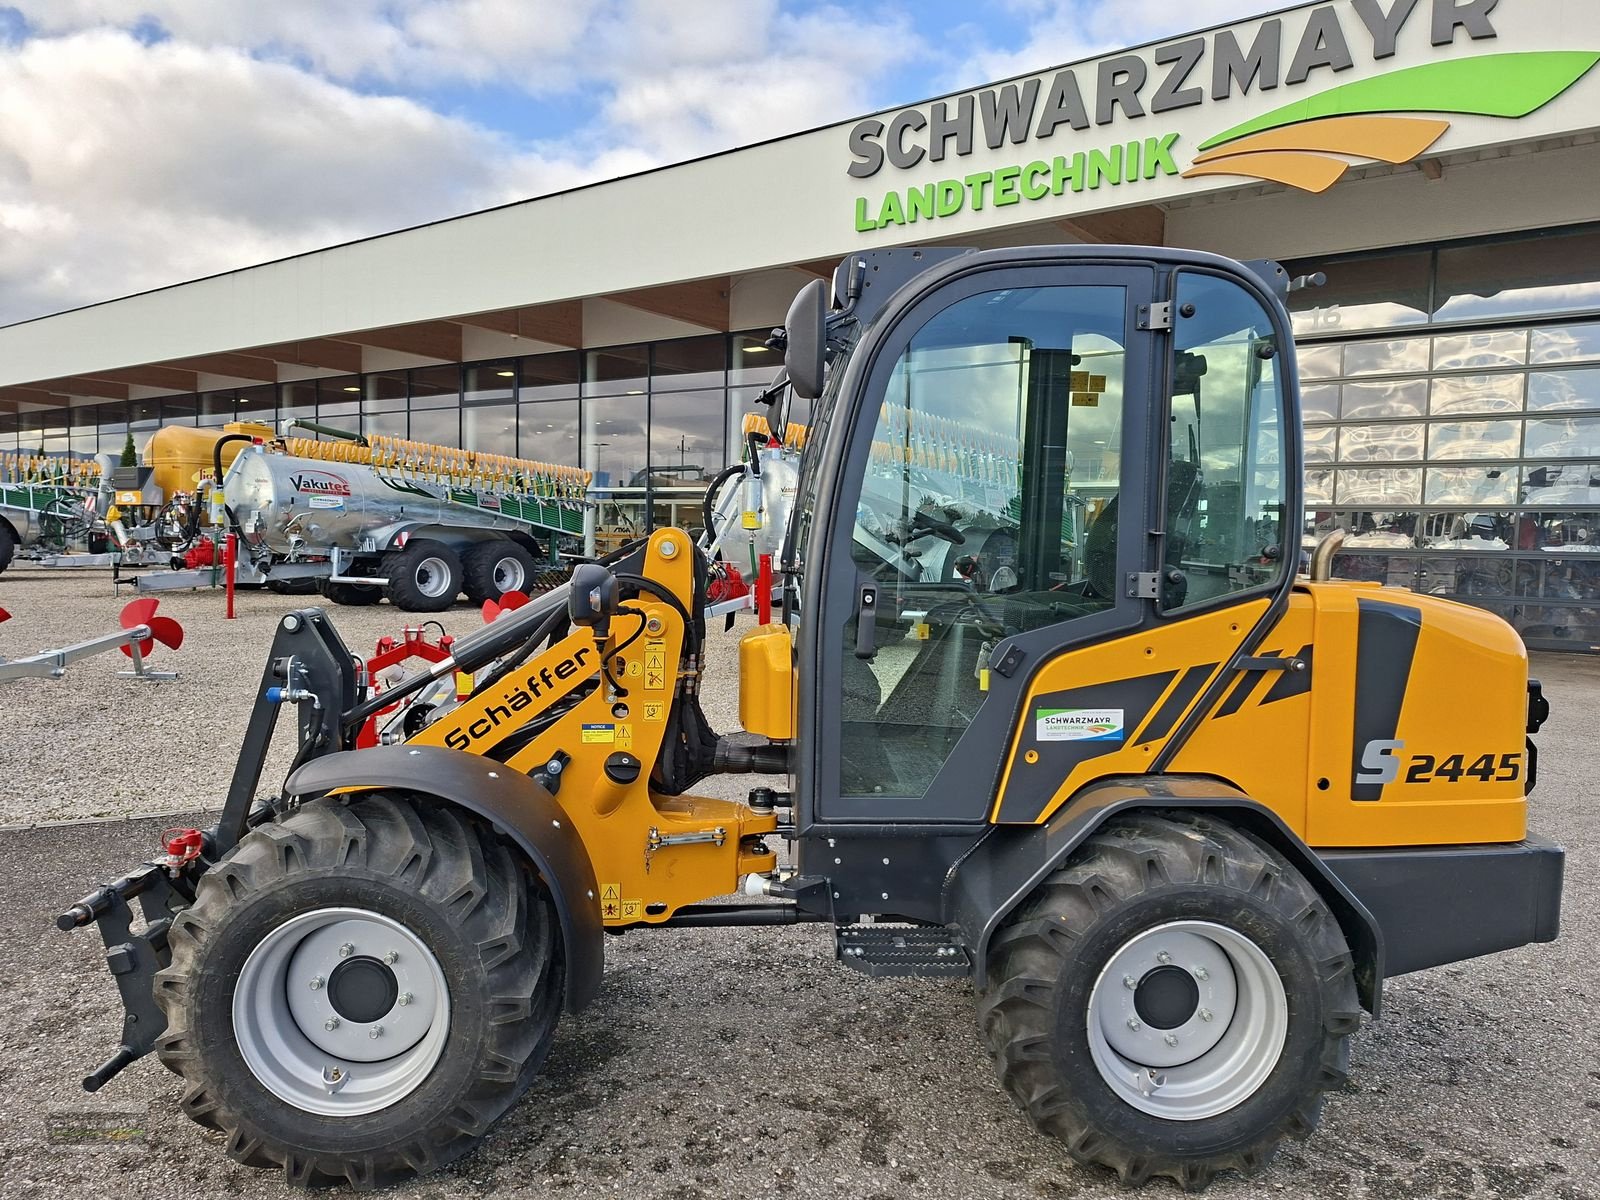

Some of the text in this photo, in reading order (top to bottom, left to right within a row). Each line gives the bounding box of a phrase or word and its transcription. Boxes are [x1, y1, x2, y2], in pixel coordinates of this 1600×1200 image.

[847, 0, 1498, 178] SCHWARZMAYR
[855, 132, 1180, 232] LANDTECHNIK
[1310, 304, 1341, 329] 16
[289, 474, 351, 492] Vakutec
[444, 647, 591, 750] Schäffer
[1355, 739, 1522, 784] S 2445
